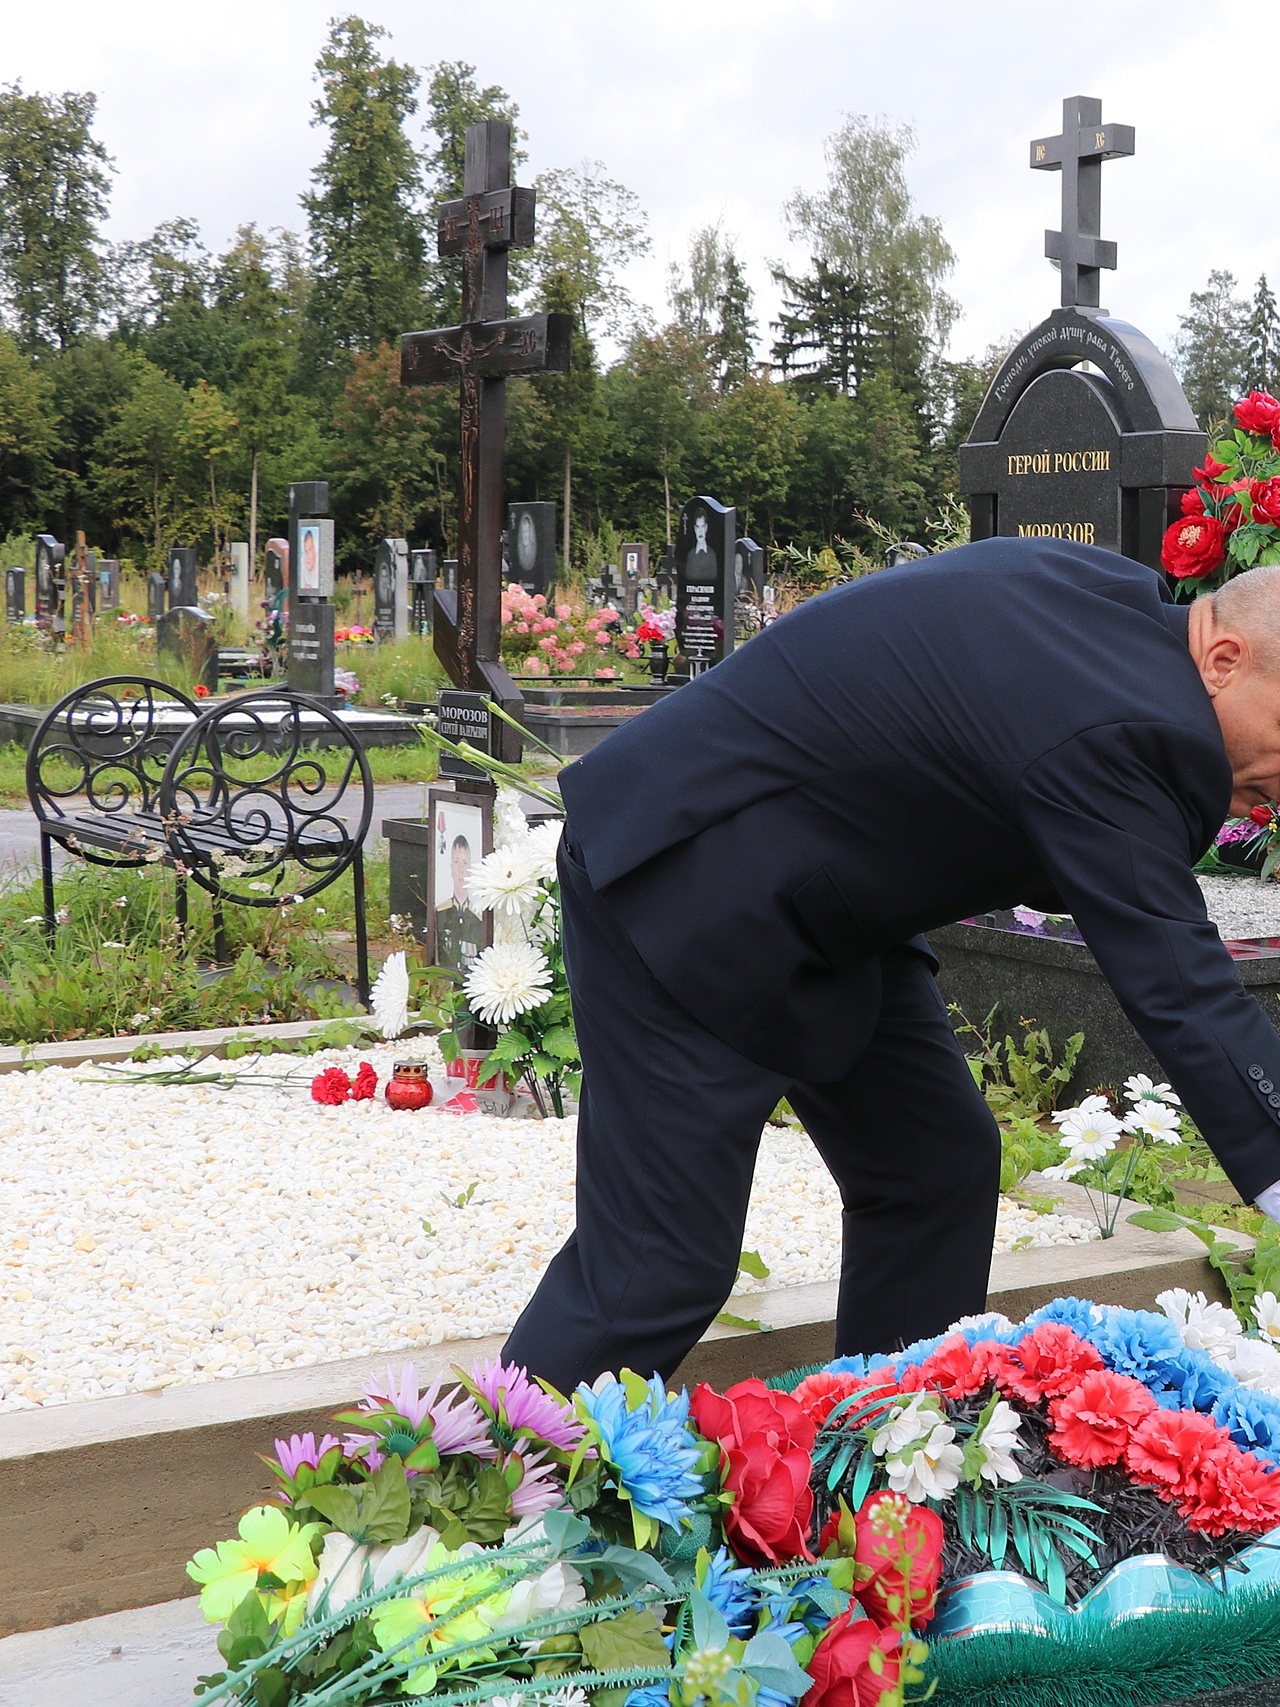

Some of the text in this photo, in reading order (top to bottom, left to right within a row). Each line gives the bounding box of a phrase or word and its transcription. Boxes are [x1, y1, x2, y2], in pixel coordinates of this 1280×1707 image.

[1059, 326, 1086, 343] душу
[1086, 331, 1107, 353] раба
[1007, 448, 1111, 475] ГЕРОЙ РОССИИ
[441, 706, 488, 723] МОРОЗОВ
